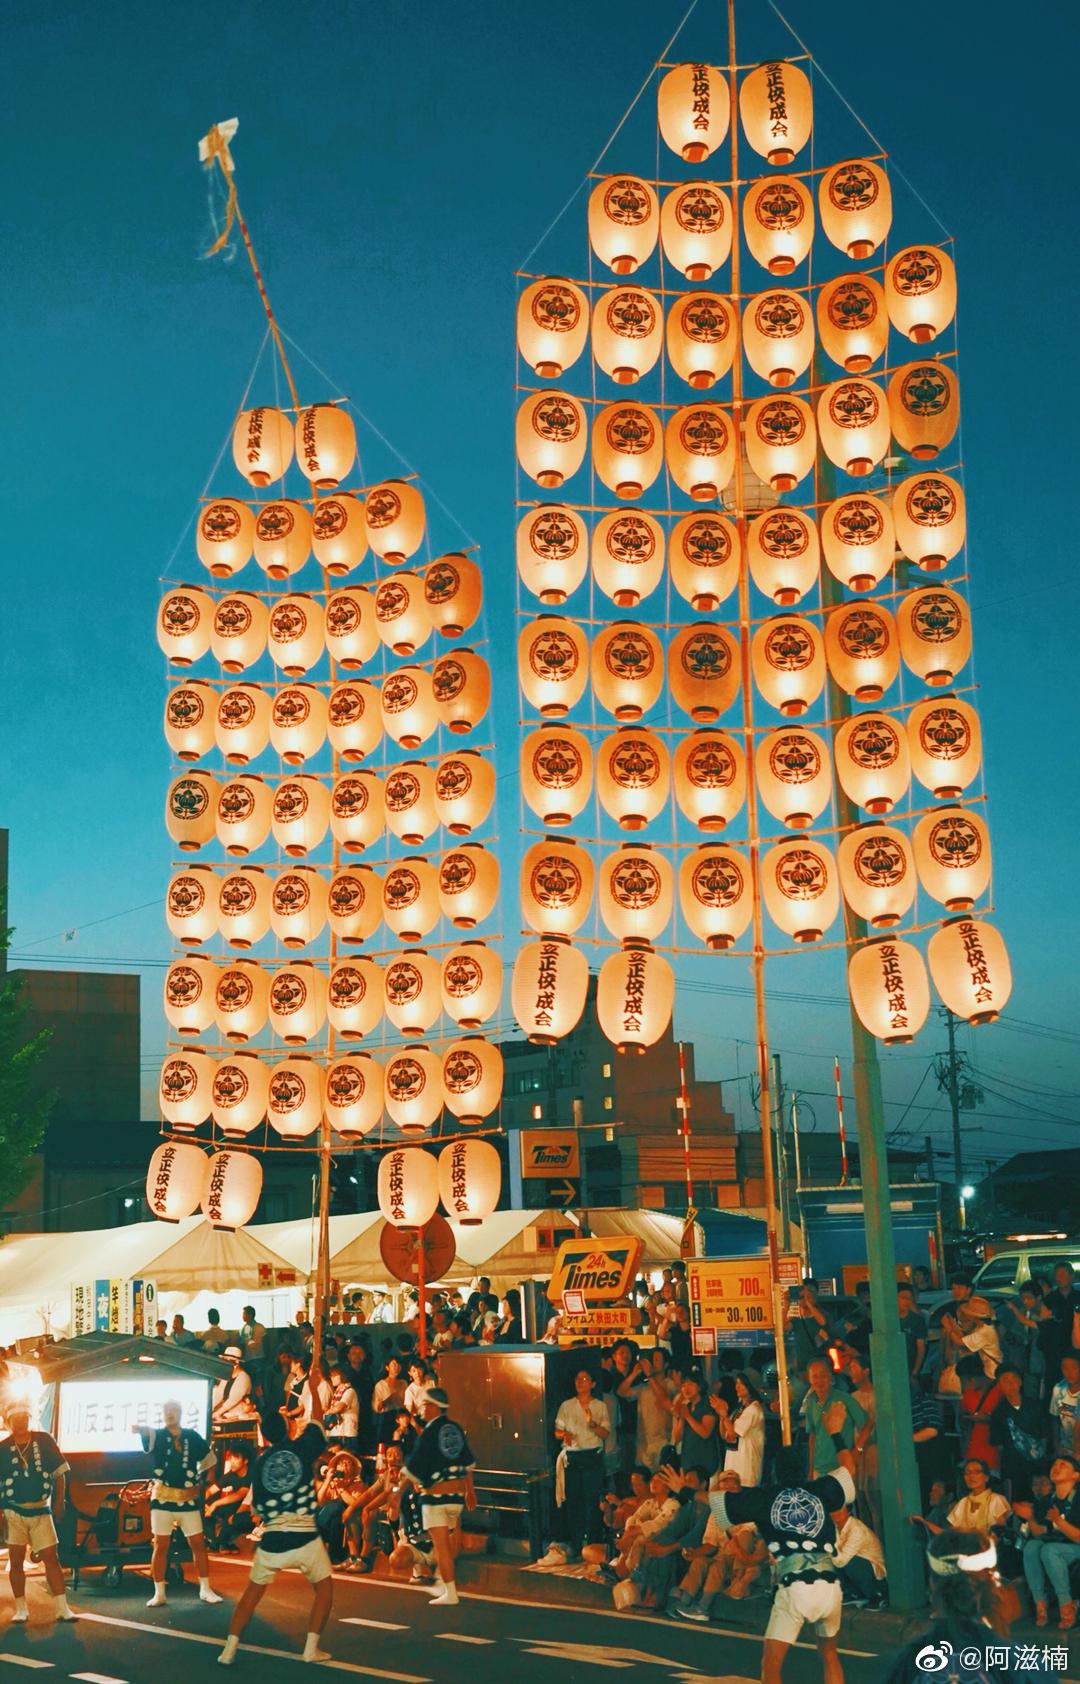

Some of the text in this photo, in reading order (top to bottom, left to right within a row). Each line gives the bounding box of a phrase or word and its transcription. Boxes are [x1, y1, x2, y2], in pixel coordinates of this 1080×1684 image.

[534, 943, 560, 1027] 立正佼成会
[623, 952, 647, 1032] 立正佼成会
[879, 945, 909, 1029] 立正佼成会
[958, 923, 993, 1004] 立正佼成会
[154, 1147, 177, 1212] 立正佼成会
[209, 1154, 231, 1220] 立正佼成会
[389, 1152, 406, 1220] 立正佼成会
[451, 1143, 470, 1212] 立正佼成会
[533, 1147, 570, 1163] Times
[560, 1255, 623, 1290] Times
